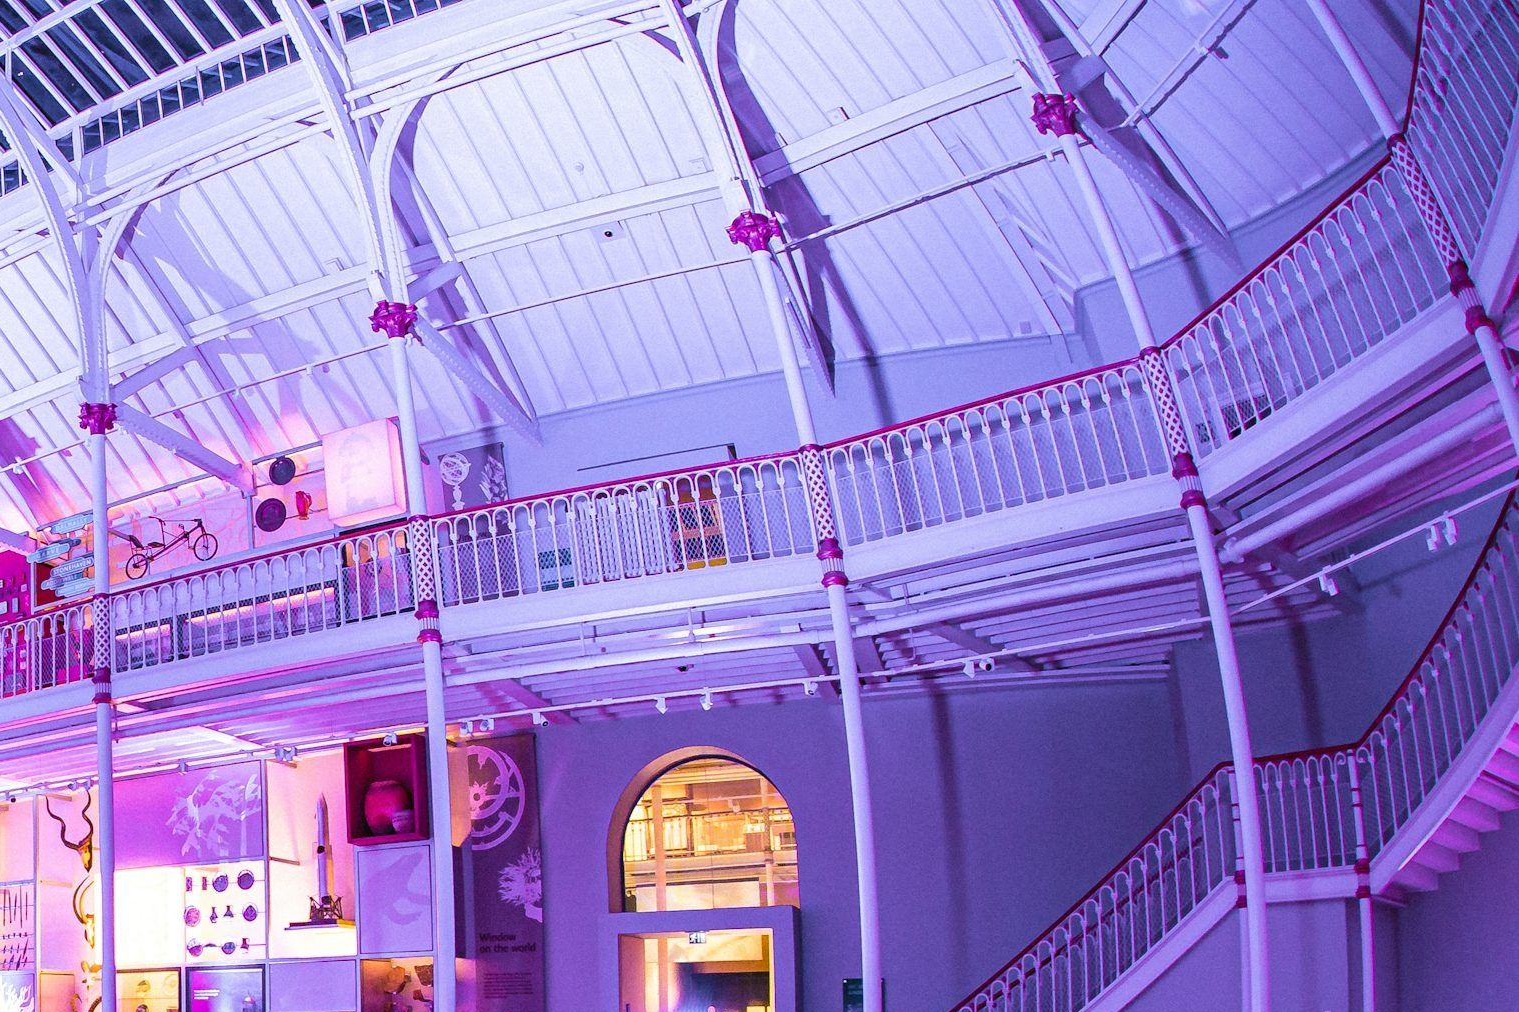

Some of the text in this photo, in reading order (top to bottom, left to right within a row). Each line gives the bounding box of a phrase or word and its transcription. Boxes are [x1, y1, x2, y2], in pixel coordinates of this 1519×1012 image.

[52, 558, 92, 575] STONEHAVEN
[479, 932, 517, 942] Window
[494, 944, 509, 953] the
[511, 942, 536, 953] world
